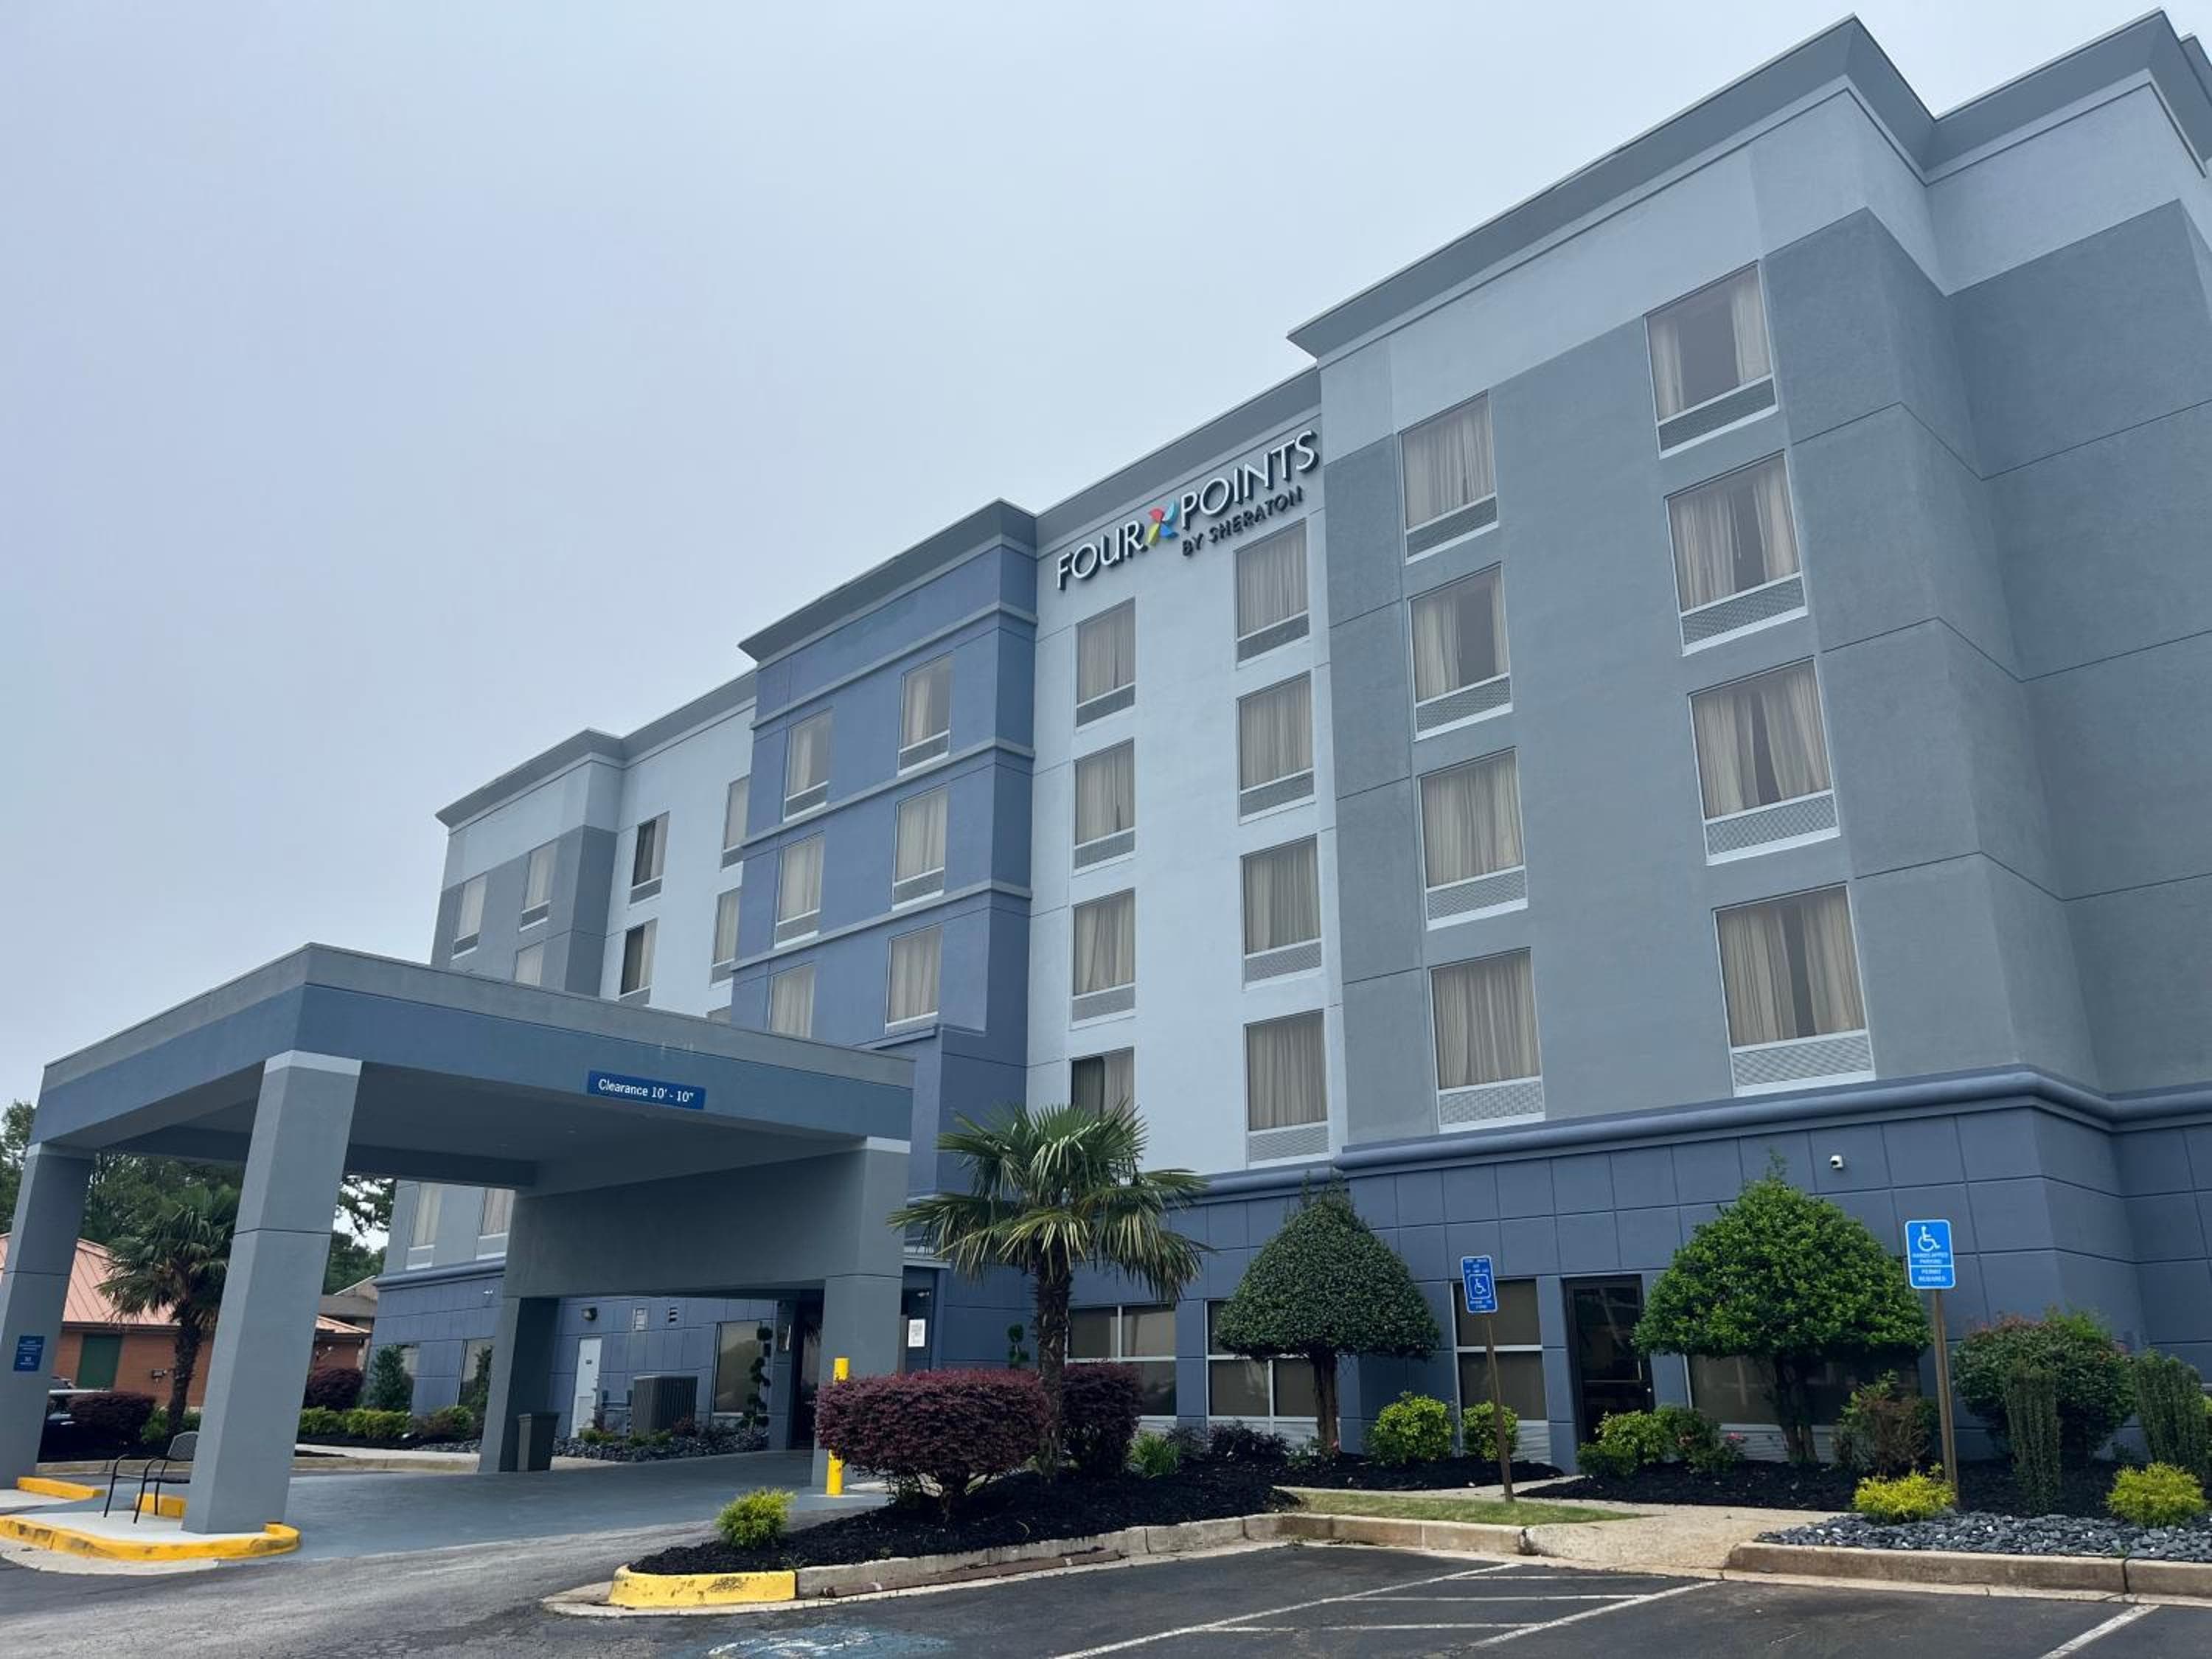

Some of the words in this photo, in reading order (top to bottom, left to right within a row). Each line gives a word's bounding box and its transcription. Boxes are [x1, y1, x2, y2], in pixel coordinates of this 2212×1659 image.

[1057, 520, 1147, 591] FOUR
[1180, 430, 1318, 530] POINTS
[1182, 532, 1203, 556] BY
[1209, 485, 1303, 543] SHERATON
[598, 1079, 648, 1096] Clearance
